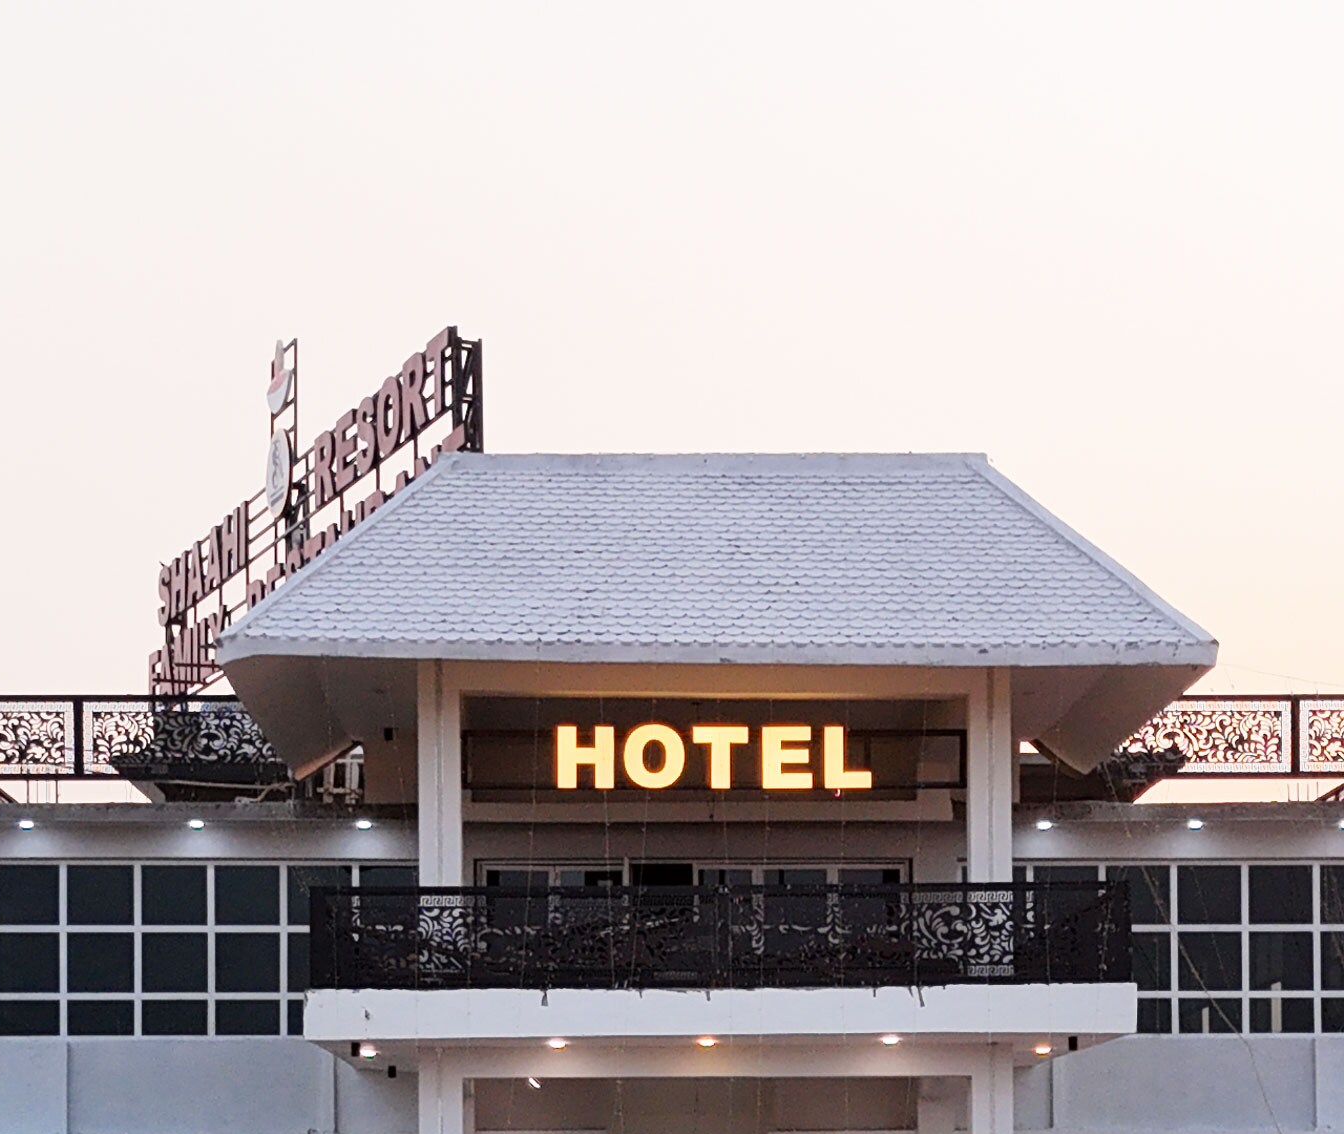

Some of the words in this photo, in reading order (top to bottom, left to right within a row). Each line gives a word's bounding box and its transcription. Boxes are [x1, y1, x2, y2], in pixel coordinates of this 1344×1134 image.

[158, 500, 249, 627] SHAAHI
[314, 326, 457, 508] RESORT
[556, 724, 873, 790] HOTEL
